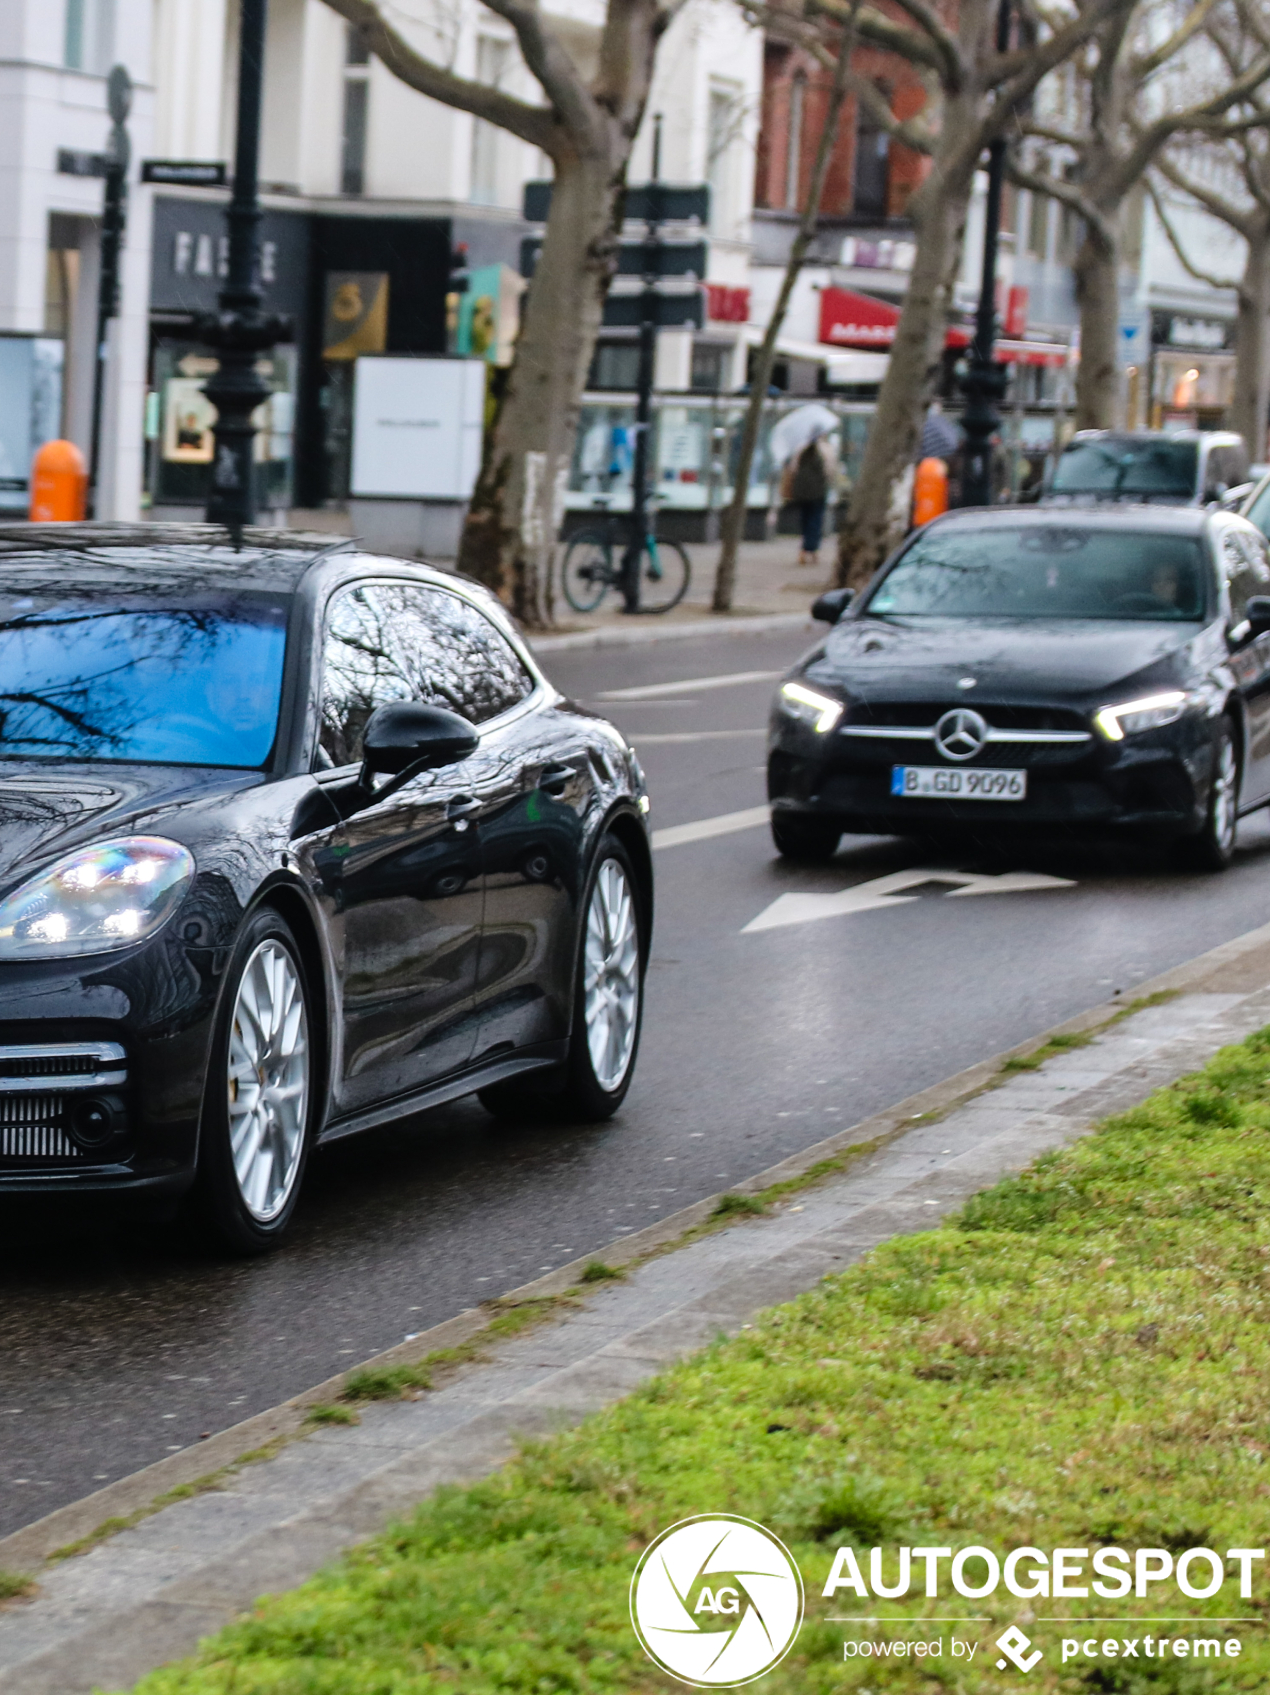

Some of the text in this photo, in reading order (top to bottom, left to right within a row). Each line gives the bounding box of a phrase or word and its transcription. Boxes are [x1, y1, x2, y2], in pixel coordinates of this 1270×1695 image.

[906, 769, 1021, 794] B GD 9096
